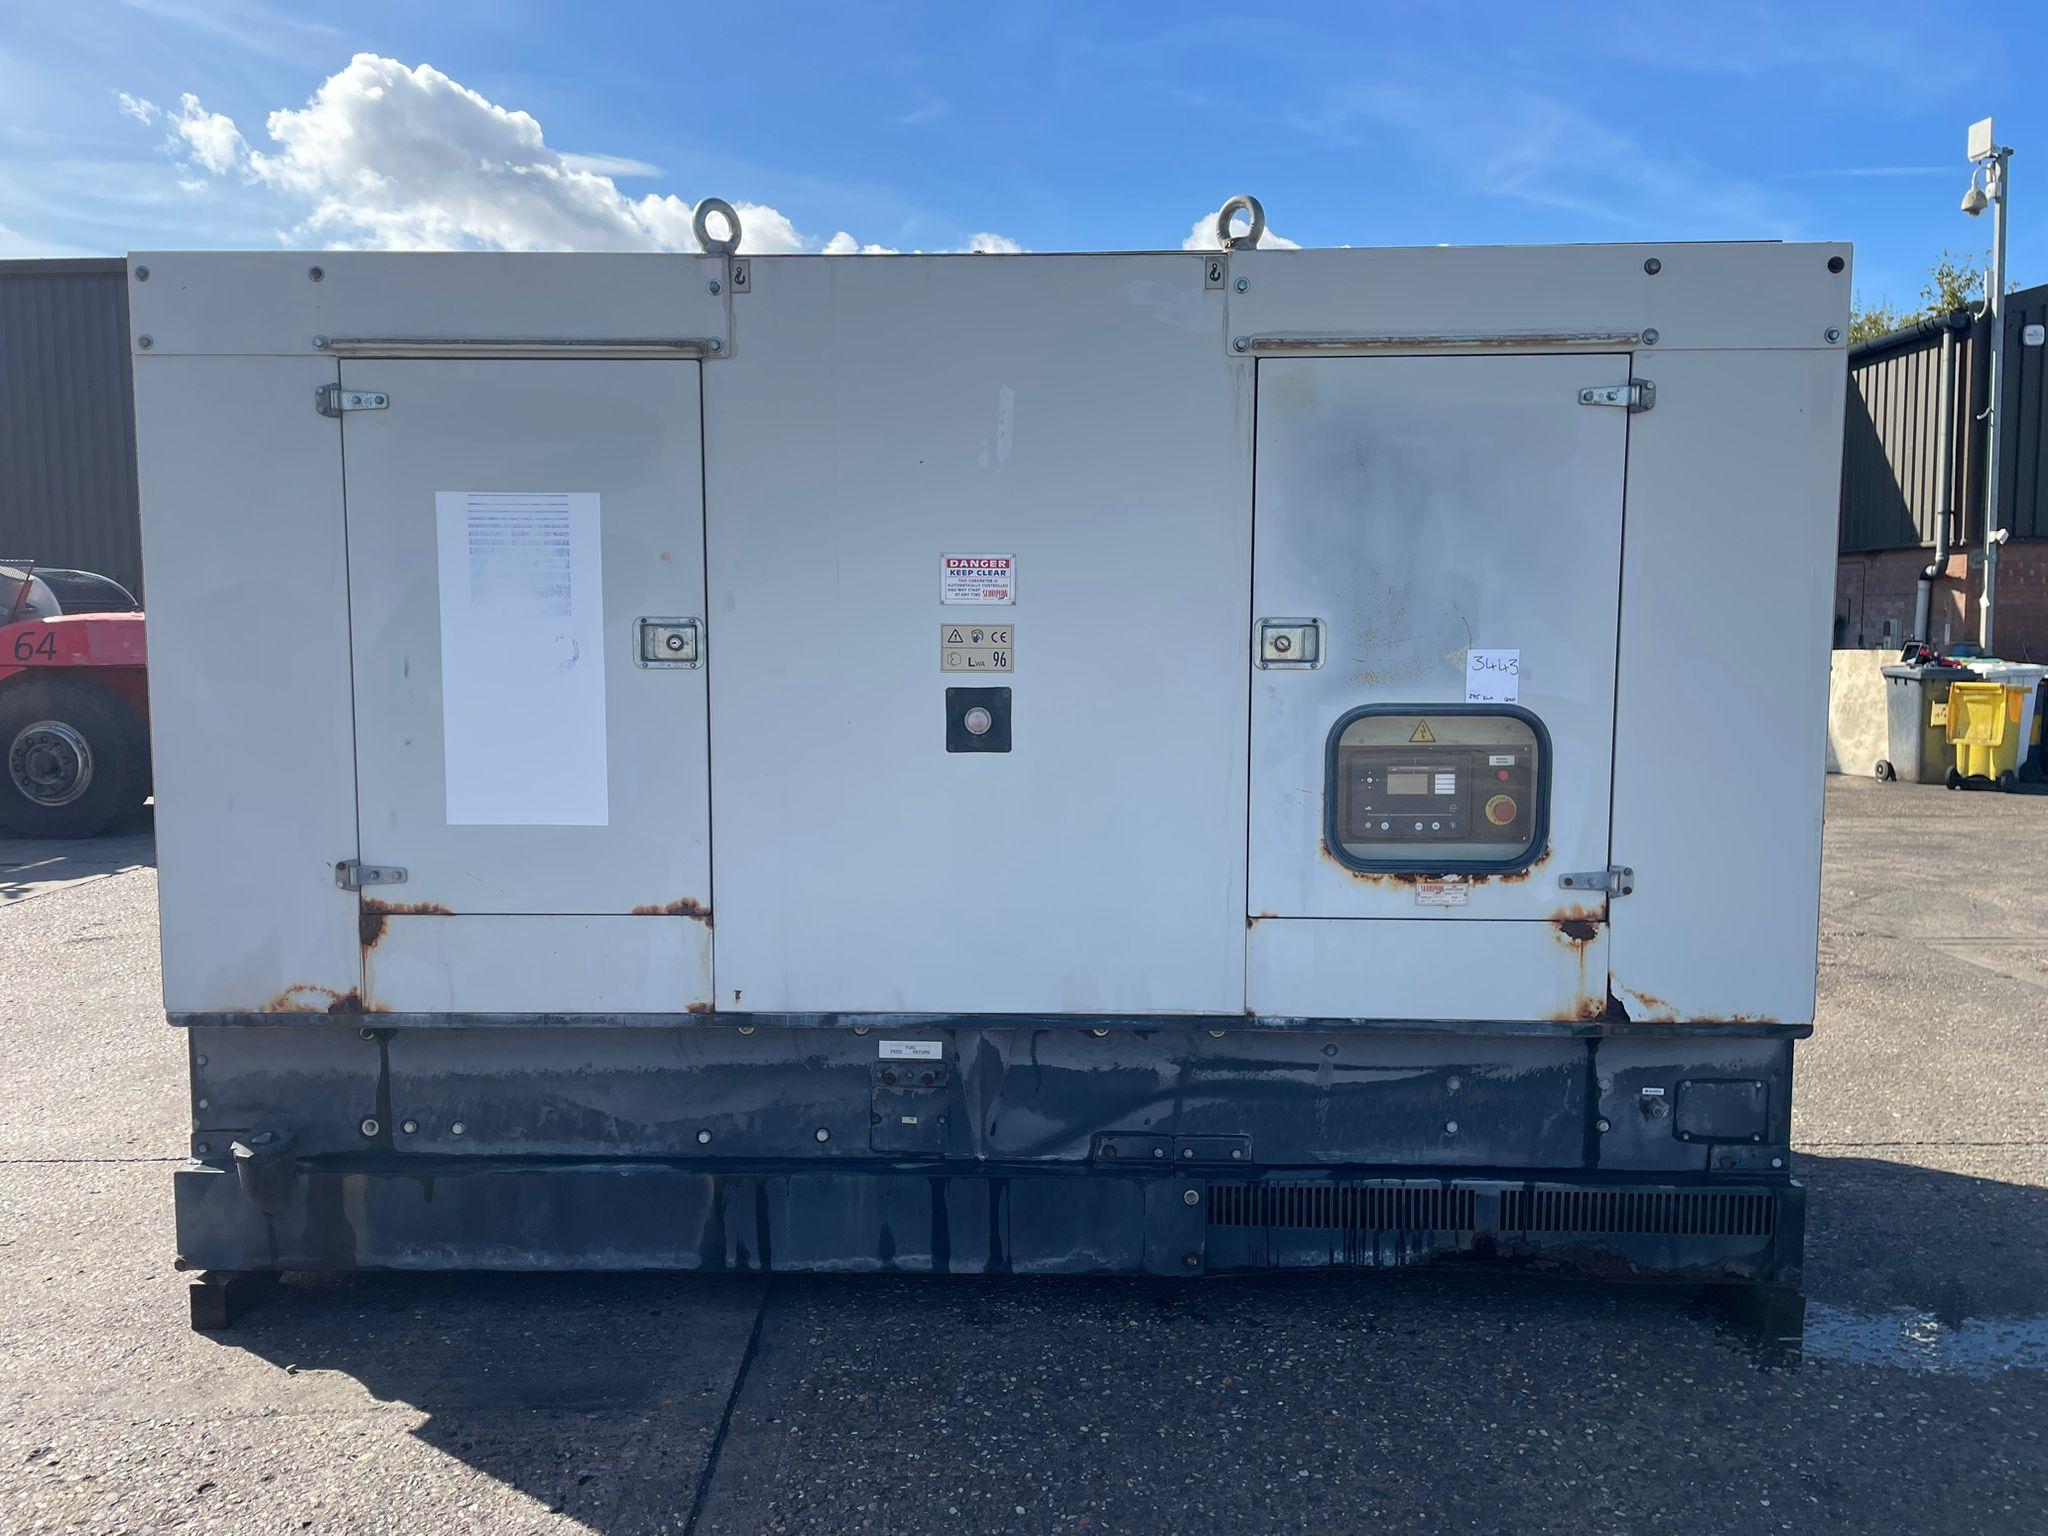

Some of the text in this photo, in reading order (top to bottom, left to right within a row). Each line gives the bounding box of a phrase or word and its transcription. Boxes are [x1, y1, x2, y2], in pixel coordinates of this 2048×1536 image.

[949, 559, 1007, 568] DANGER
[14, 631, 57, 661] 64
[993, 651, 1007, 668] 96
[1471, 655, 1519, 676] 3443
